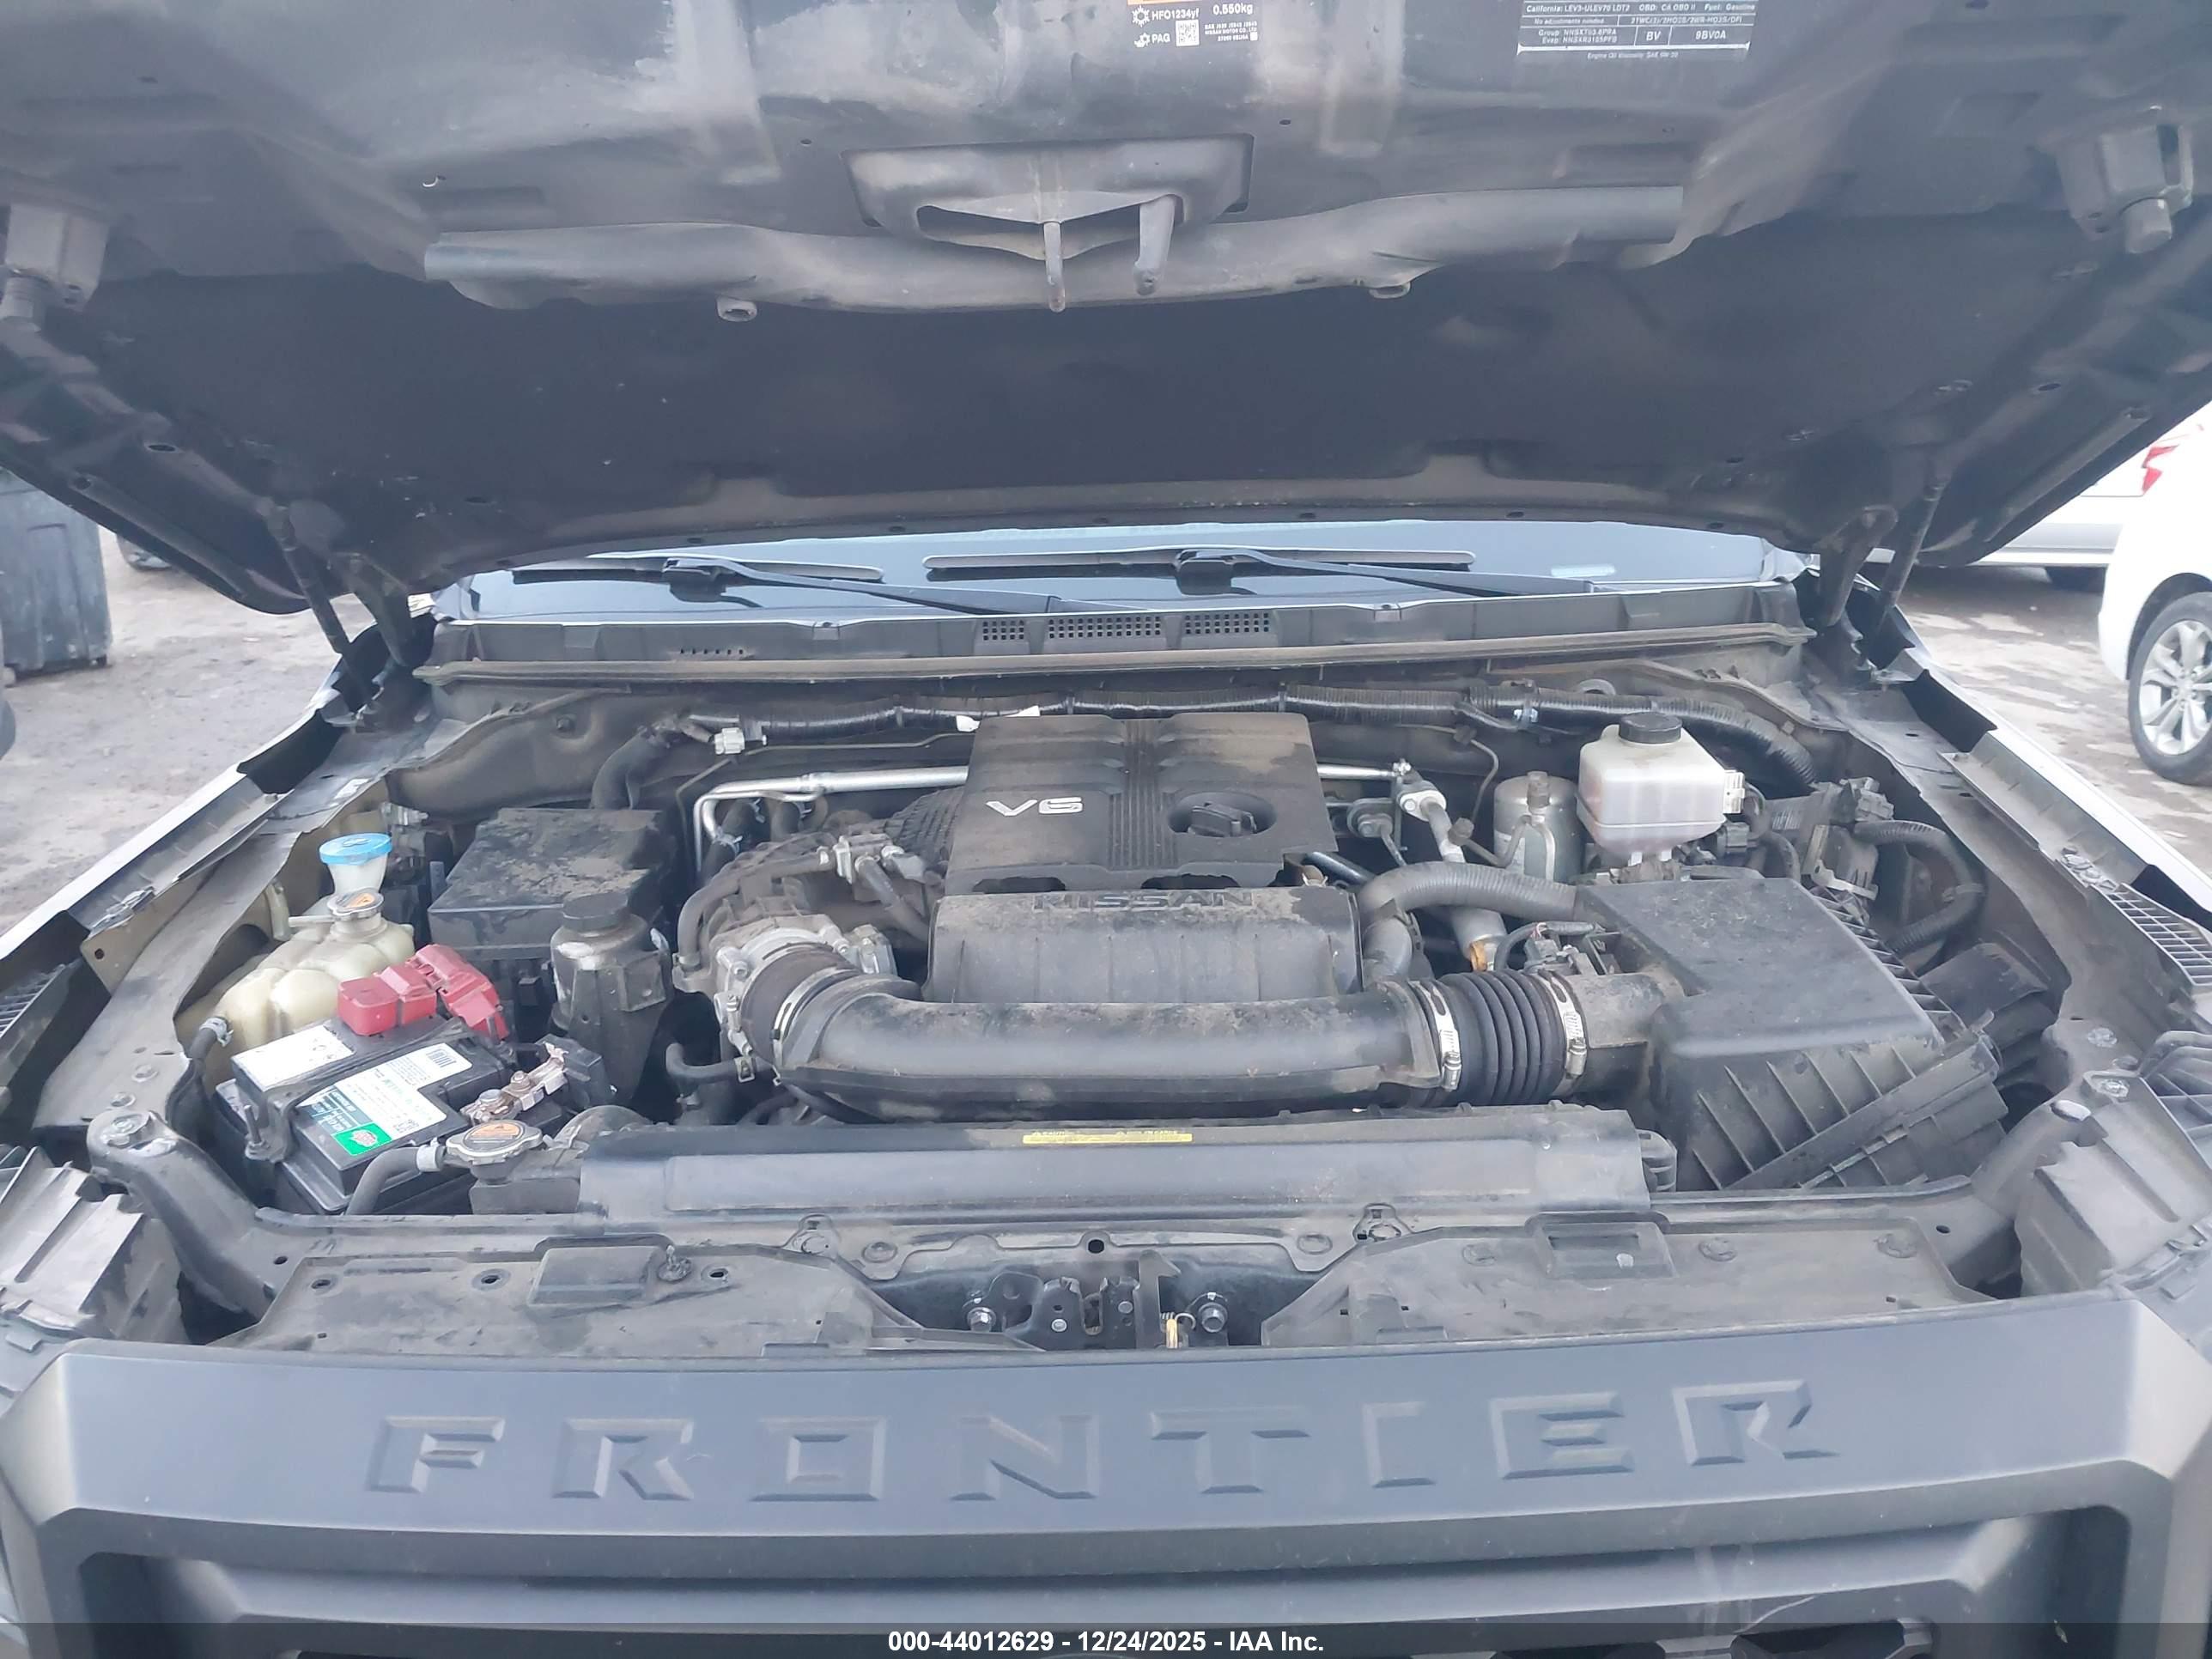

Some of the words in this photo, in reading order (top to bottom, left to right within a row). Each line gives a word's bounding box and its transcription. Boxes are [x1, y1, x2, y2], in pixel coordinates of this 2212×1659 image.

[1152, 8, 1200, 21] HFO1234yf
[1212, 3, 1254, 15] 0.550kg
[1152, 33, 1171, 44] PAG
[1646, 30, 1662, 41] BV
[985, 795, 1085, 817] V6
[1030, 887, 1255, 912] NISSAN
[365, 1378, 1840, 1501] FRONTIER
